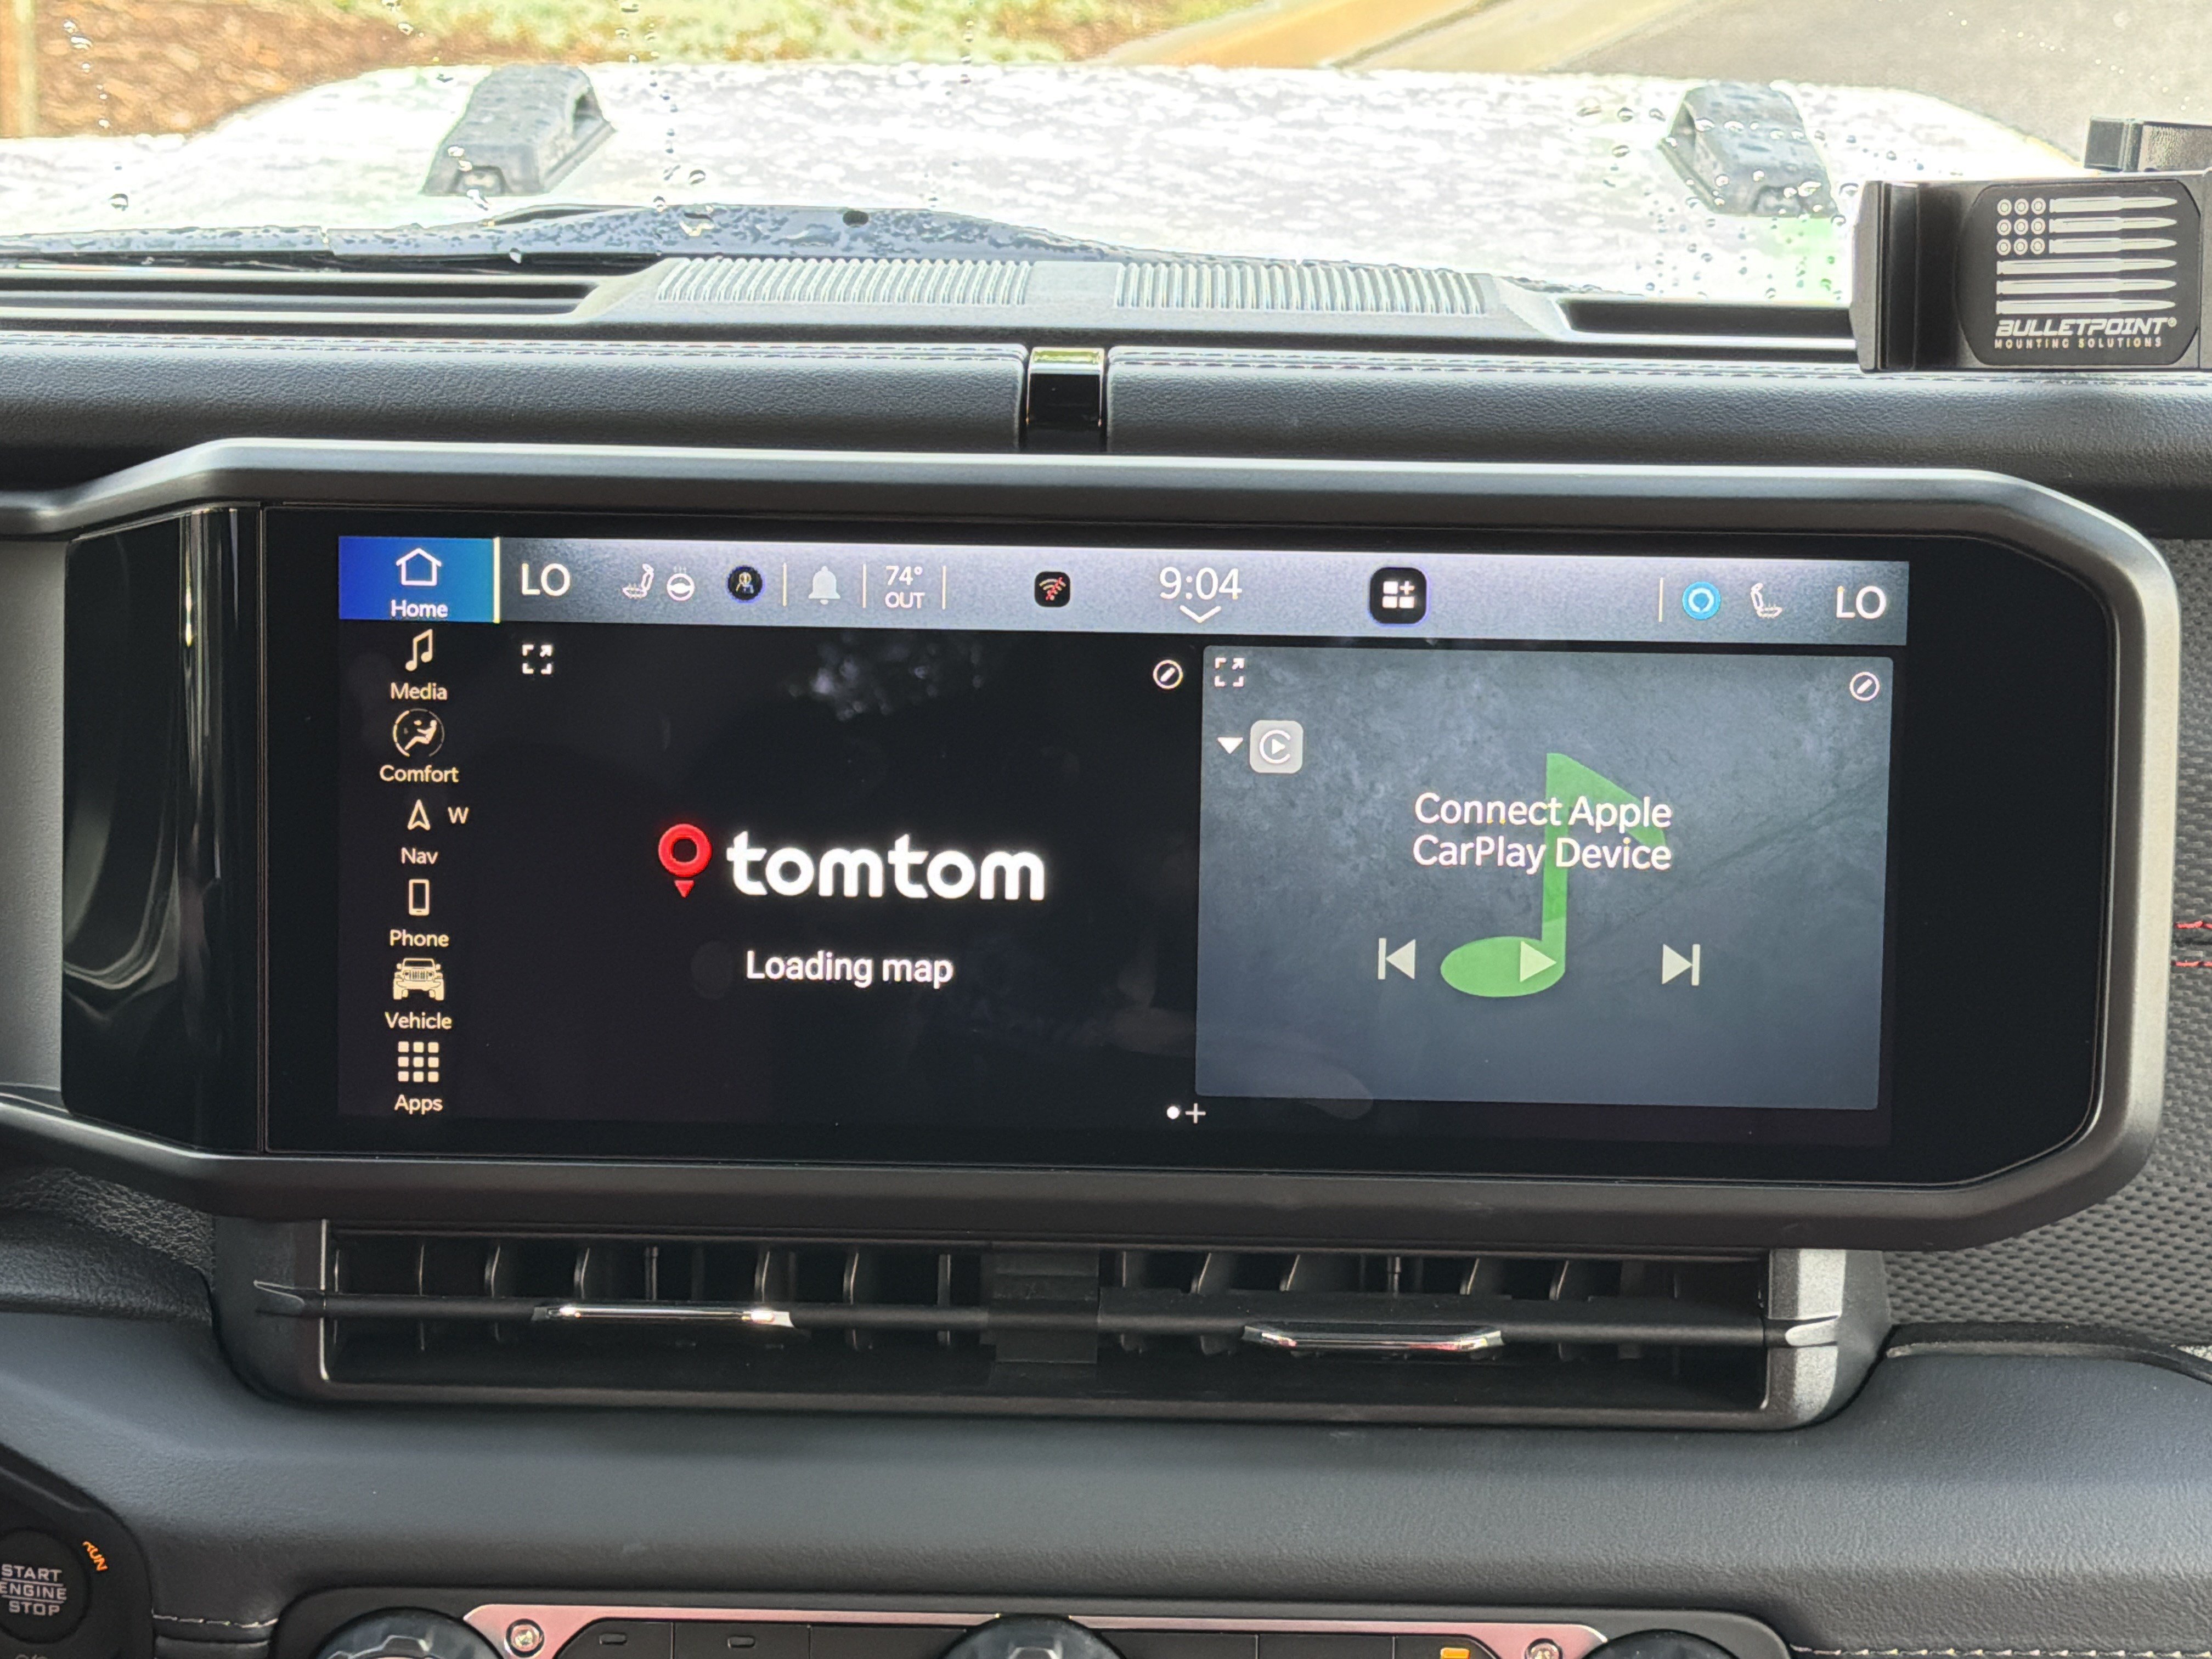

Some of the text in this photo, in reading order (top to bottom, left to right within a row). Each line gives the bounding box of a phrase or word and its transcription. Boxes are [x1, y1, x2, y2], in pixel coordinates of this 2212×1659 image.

[1994, 337, 2162, 349] MOUNTING SOLUTIONS
[521, 563, 571, 596] LO
[885, 566, 924, 586] 74°
[1158, 566, 1242, 600] 9:04
[391, 599, 448, 618] Home
[884, 592, 925, 610] OUT
[1835, 585, 1887, 620] LO
[391, 682, 448, 701] Media
[379, 764, 460, 783] Comfort
[447, 807, 470, 824] W
[1414, 792, 1673, 833] Connect Apple
[400, 847, 439, 865] Nav
[1412, 834, 1672, 874] CarPlay Device
[726, 831, 1045, 901] tomtom
[390, 929, 450, 947] Phone
[746, 950, 954, 989] Loading map
[385, 1012, 453, 1030] Vehicle
[394, 1094, 444, 1115] Apps
[82, 1541, 108, 1571] RUN
[2, 1564, 62, 1582] START
[0, 1581, 67, 1600] ENGINE
[9, 1600, 60, 1616] STOP
